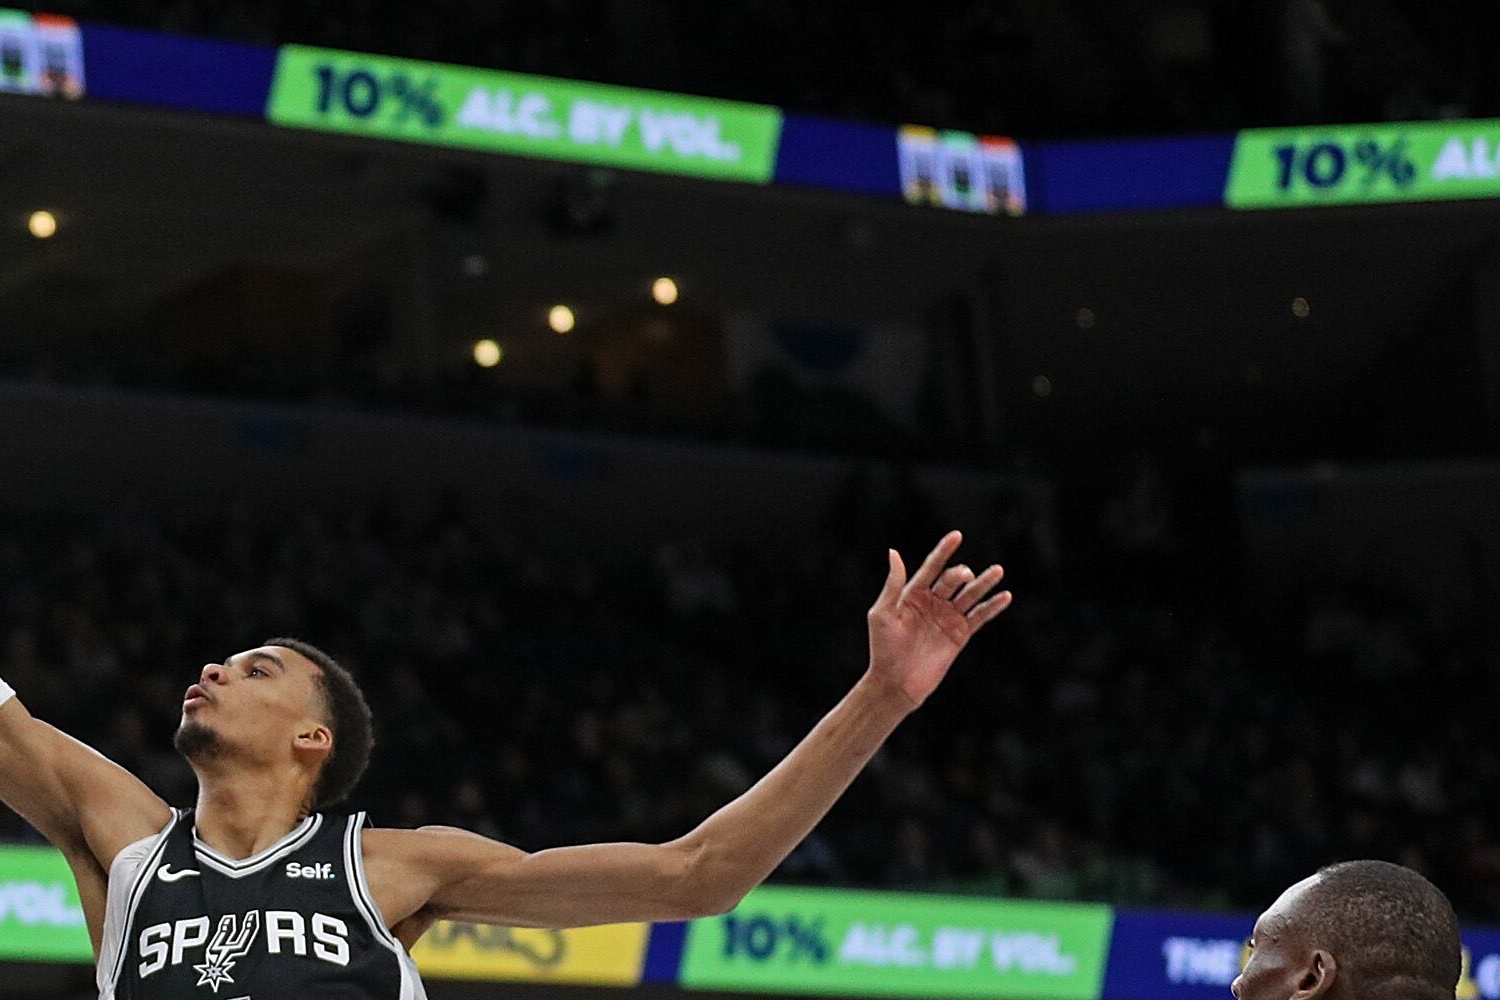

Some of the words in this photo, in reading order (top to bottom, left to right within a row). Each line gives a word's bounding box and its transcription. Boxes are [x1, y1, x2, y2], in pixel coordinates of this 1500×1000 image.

[316, 65, 444, 129] 10%
[568, 100, 632, 148] BY
[639, 107, 743, 163] VOL.
[1274, 137, 1416, 190] 10%
[1431, 136, 1500, 183] AL
[285, 862, 336, 880] Self.
[139, 909, 351, 985] SPURS
[721, 912, 832, 967] 10%
